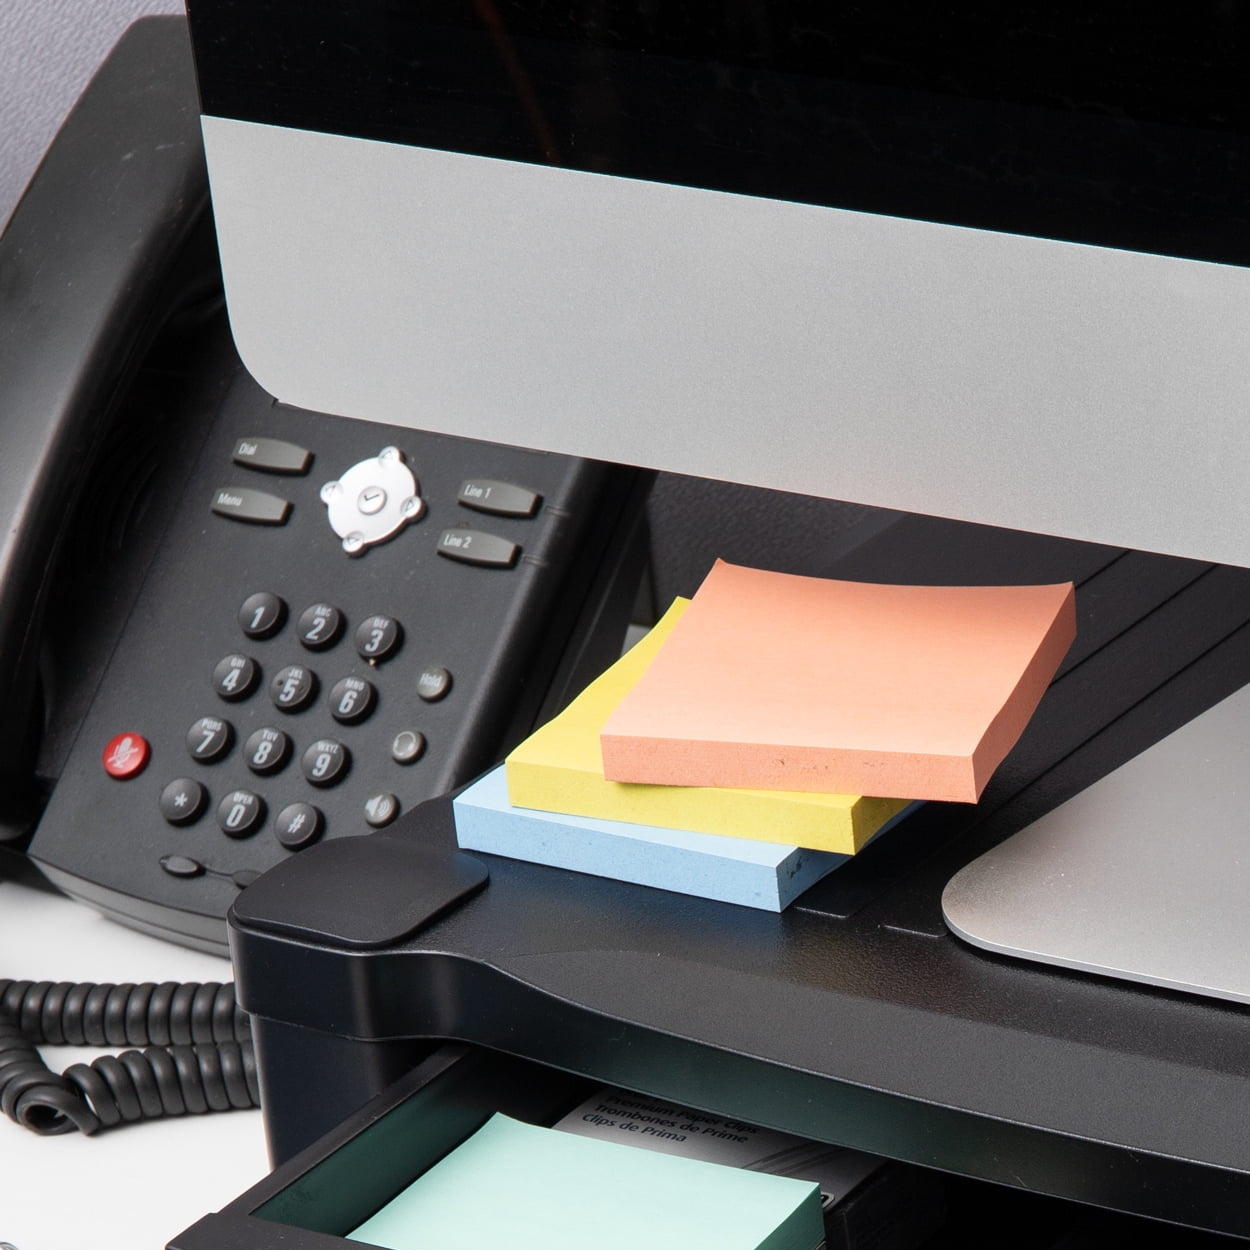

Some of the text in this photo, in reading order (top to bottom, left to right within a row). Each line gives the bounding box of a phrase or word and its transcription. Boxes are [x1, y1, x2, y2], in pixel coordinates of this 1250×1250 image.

[238, 442, 258, 456] Dial
[217, 493, 243, 507] Menu
[464, 484, 492, 499] Line 1
[443, 534, 472, 549] Line 2
[250, 606, 265, 628] 1
[315, 606, 332, 618] ABC
[305, 618, 326, 640] 2
[364, 629, 384, 652] 3
[222, 669, 241, 691] 4
[279, 679, 300, 702] 5
[419, 673, 443, 688] Hold
[338, 691, 358, 713] 6
[196, 731, 215, 753] 7
[262, 730, 279, 742] TUV
[253, 742, 273, 765] 8
[312, 754, 332, 777] 9
[226, 804, 246, 827] 0
[288, 813, 306, 833] #
[597, 1104, 749, 1143] Trombones de Prime
[607, 1095, 762, 1135] Premium Paper Clips
[582, 1113, 687, 1142] Clips de Prima
